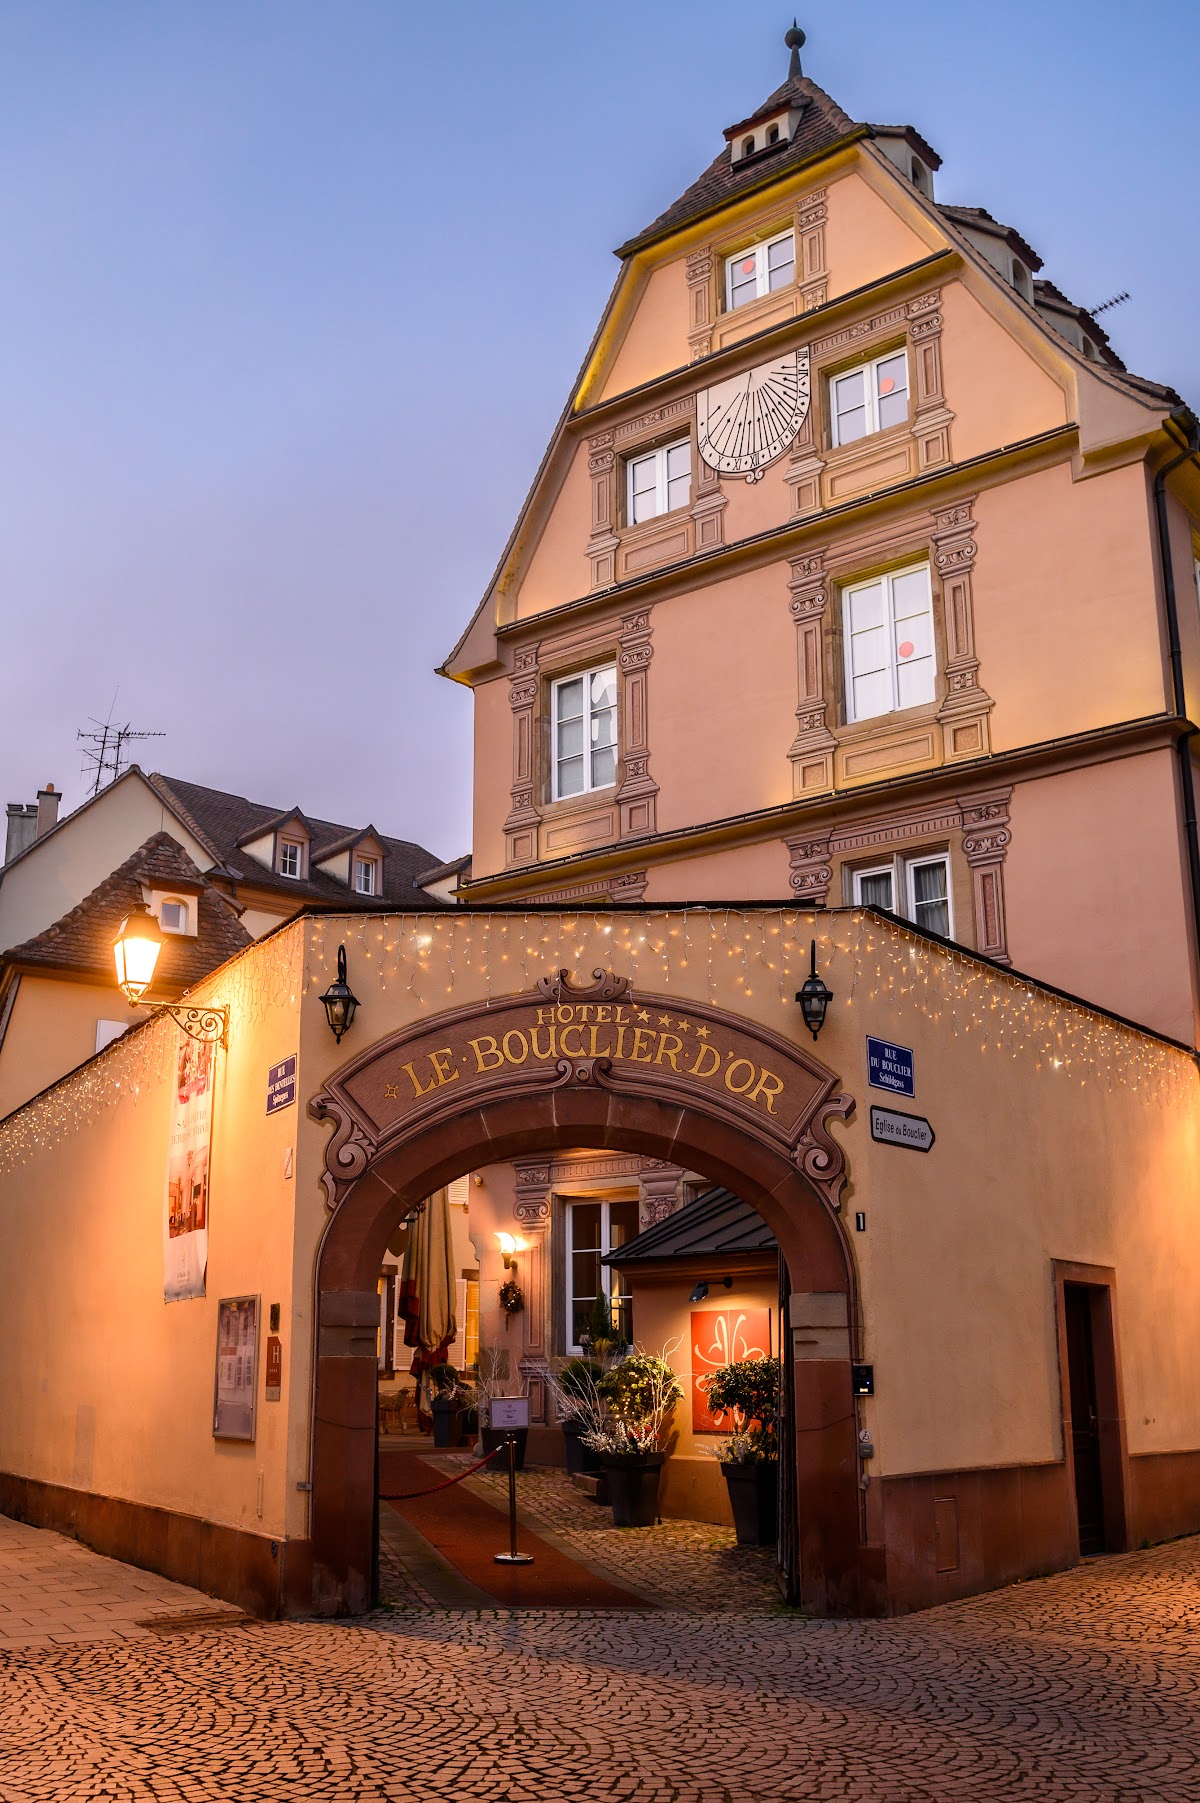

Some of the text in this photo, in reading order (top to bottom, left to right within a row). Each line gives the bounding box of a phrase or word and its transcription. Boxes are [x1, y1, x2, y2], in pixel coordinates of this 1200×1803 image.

[798, 369, 808, 380] VI
[799, 390, 808, 398] V
[795, 407, 805, 418] IV
[788, 425, 797, 436] III
[778, 438, 786, 448] II
[768, 448, 772, 458] I
[715, 456, 724, 469] X
[732, 459, 742, 470] XI
[750, 453, 760, 468] XII
[536, 1005, 630, 1025] HOTEL
[885, 1048, 897, 1060] RUE
[402, 1024, 785, 1114] LE BOUCLIER D'OR
[870, 1056, 911, 1077] DU BOUCLIER
[879, 1072, 904, 1088] Schildgass
[896, 1125, 902, 1135] du
[903, 1124, 926, 1141] Bouclier
[858, 1214, 863, 1229] 1
[273, 1346, 280, 1363] H
